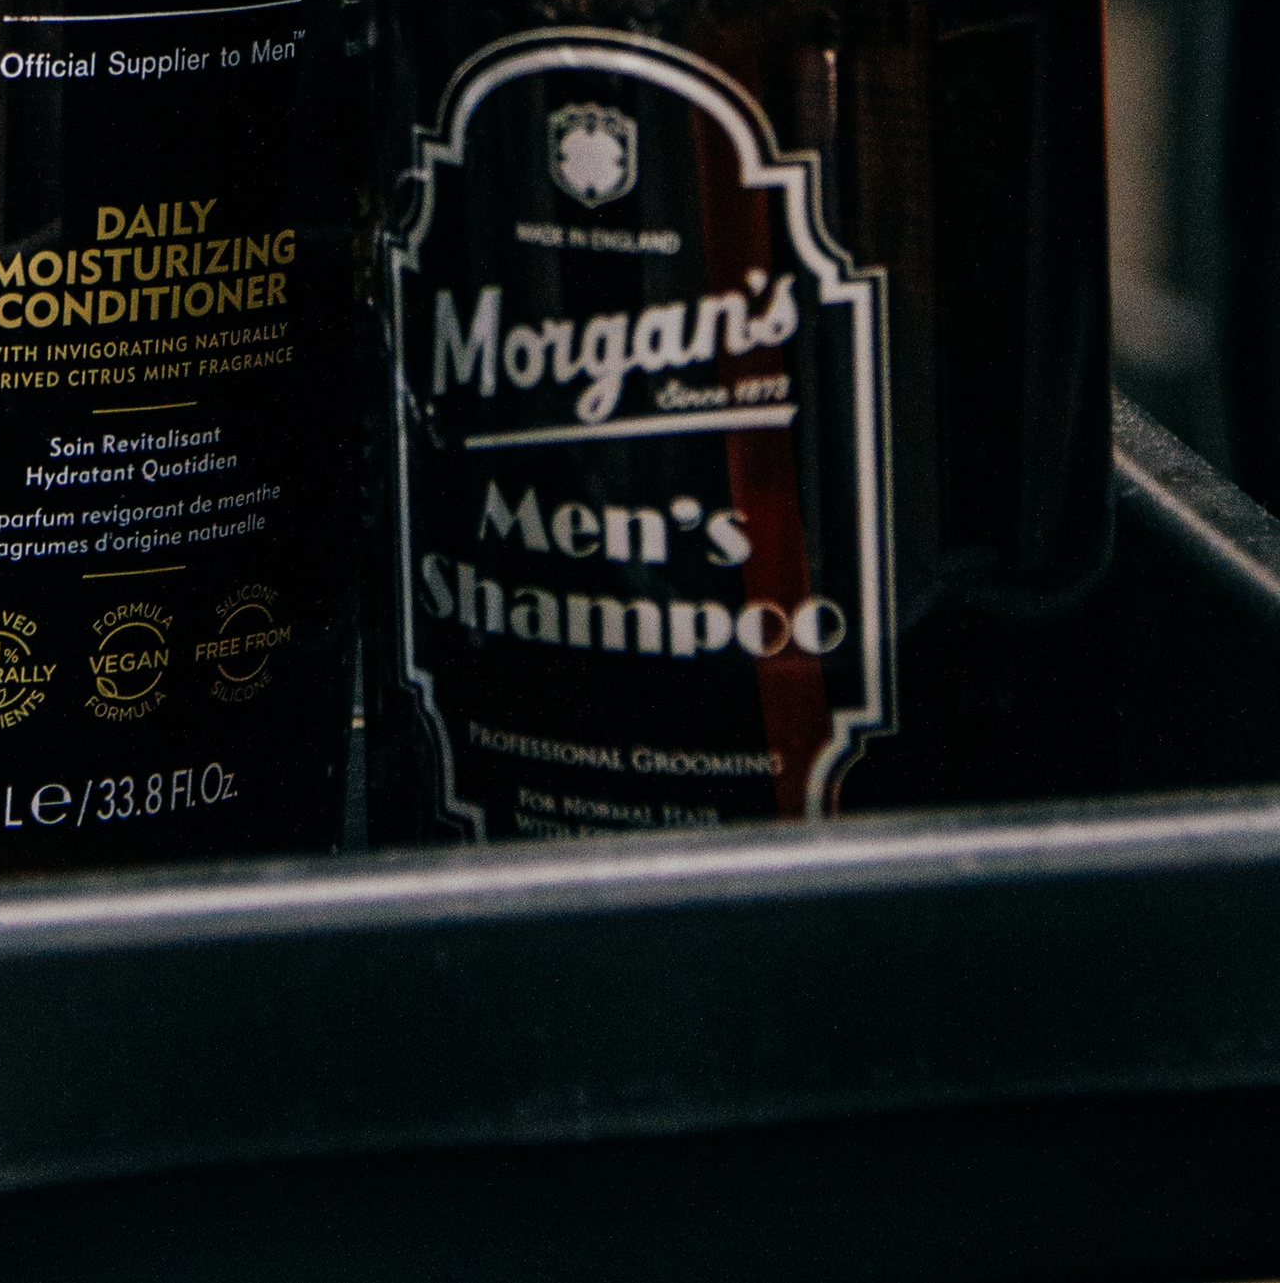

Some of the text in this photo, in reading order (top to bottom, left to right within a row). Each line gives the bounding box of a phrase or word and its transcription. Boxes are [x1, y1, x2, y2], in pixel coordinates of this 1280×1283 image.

[0, 52, 95, 79] Official
[108, 47, 210, 80] Supplier
[220, 46, 241, 67] to
[97, 198, 217, 241] DAILY
[47, 335, 188, 362] INVIGORATING
[195, 322, 289, 350] NATURALLY
[431, 266, 799, 424] Morgan's
[68, 367, 136, 386] CITRUS
[143, 361, 192, 381] MINT
[199, 346, 294, 376] FRAGRANCE
[49, 428, 221, 457] Soin Revitalisant
[26, 453, 238, 490] Hydratant Quotidien
[81, 500, 184, 528] revigorant
[190, 496, 213, 515] de
[218, 484, 281, 511] menthe
[480, 479, 753, 565] Men's
[95, 530, 182, 553] d'origine
[188, 513, 266, 542] naturelle
[92, 601, 174, 635] FORMULA
[215, 583, 280, 618] SILICONE
[421, 553, 847, 658] Shampoo
[89, 648, 170, 675] VEGAN
[195, 625, 292, 662] FREE FROM
[210, 669, 273, 703] SILICONE
[85, 690, 167, 722] FORMULA
[470, 720, 784, 776] PROFESSIONAL GROOMING
